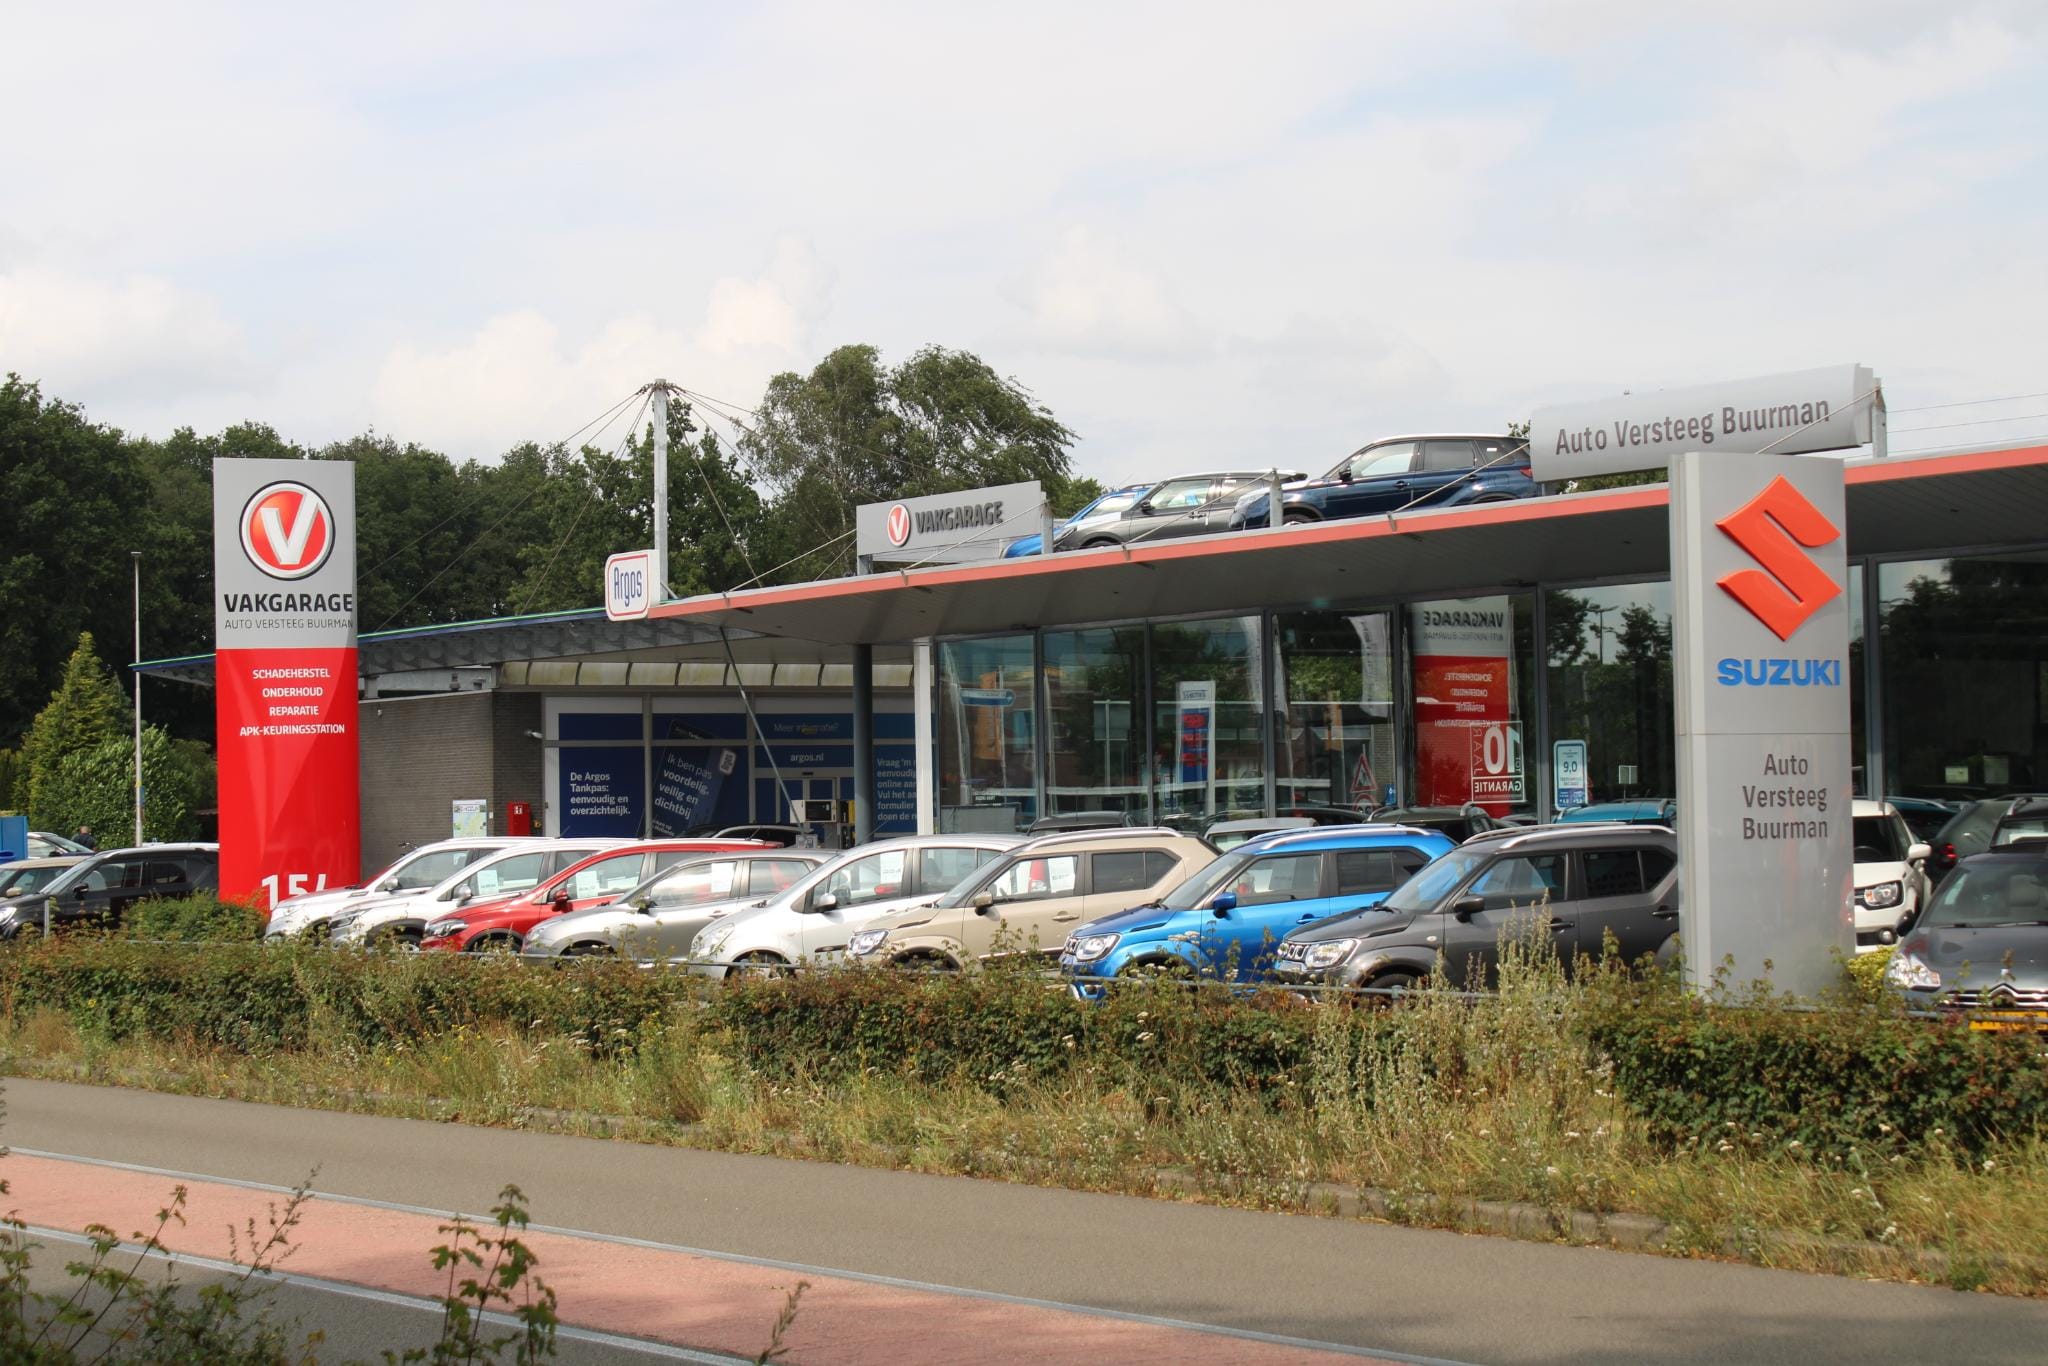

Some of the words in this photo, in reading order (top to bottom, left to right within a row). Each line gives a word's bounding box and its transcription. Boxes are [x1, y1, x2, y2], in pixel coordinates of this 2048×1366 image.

[1556, 428, 1608, 455] Auto
[1614, 412, 1714, 444] Versteeg
[1722, 399, 1830, 435] Buurman
[916, 501, 1004, 534] VAKGARAGE
[614, 566, 642, 607] Argos
[224, 593, 353, 612] VAKGARAGE
[225, 618, 252, 629] AUTO
[255, 618, 304, 629] VERSTEEG
[307, 618, 354, 629] BUURMAN
[252, 668, 330, 680] SCHADEHERSTEL
[1717, 658, 1840, 686] SUZUKI
[262, 686, 324, 698] ONDERHOUD
[269, 704, 320, 716] REPARATIE
[240, 724, 345, 736] APK-KEURINGSSTATION
[790, 753, 825, 764] argos.nl
[876, 758, 900, 768] Vraag
[1764, 753, 1808, 776] Auto
[677, 757, 695, 773] ben
[696, 767, 713, 780] pas
[1563, 760, 1578, 774] 9,0
[570, 772, 582, 781] De
[584, 772, 610, 782] Argos
[570, 784, 609, 794] Tankpas:
[877, 780, 903, 788] online
[570, 794, 616, 804] eenvoudig
[658, 783, 686, 801] veilig
[686, 794, 700, 806] en
[876, 790, 890, 799] Vul
[892, 790, 906, 799] het
[1742, 785, 1828, 812] Versteeg
[570, 806, 631, 816] overzichtelijk.
[654, 796, 692, 820] dichtbij
[878, 801, 914, 810] formulier
[878, 812, 898, 820] doen
[899, 812, 910, 820] de
[1743, 817, 1828, 840] Buurman
